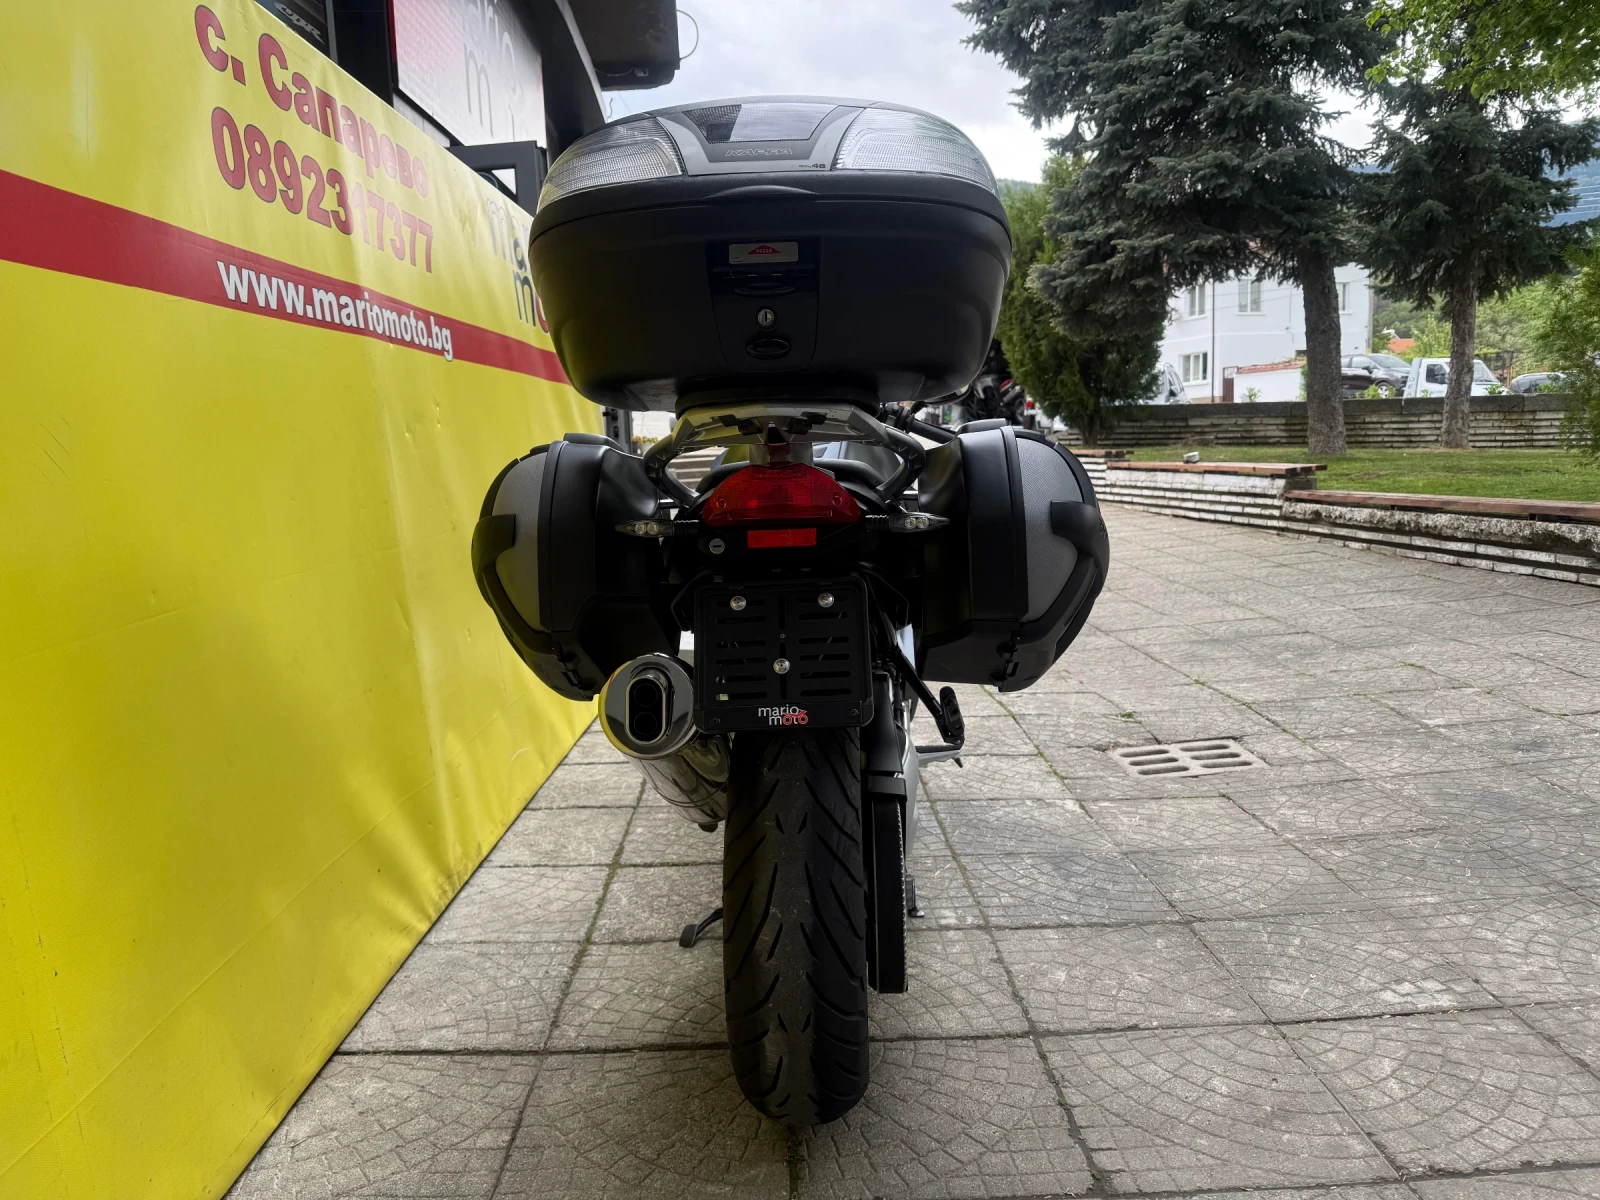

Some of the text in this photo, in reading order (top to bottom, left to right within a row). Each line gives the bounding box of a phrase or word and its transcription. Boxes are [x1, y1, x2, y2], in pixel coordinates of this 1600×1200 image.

[258, 33, 428, 198] Сапарево
[211, 106, 433, 273] 0892317377
[216, 260, 453, 362] www.mariomoto.bg
[758, 703, 800, 717] mario
[768, 714, 809, 726] moto
